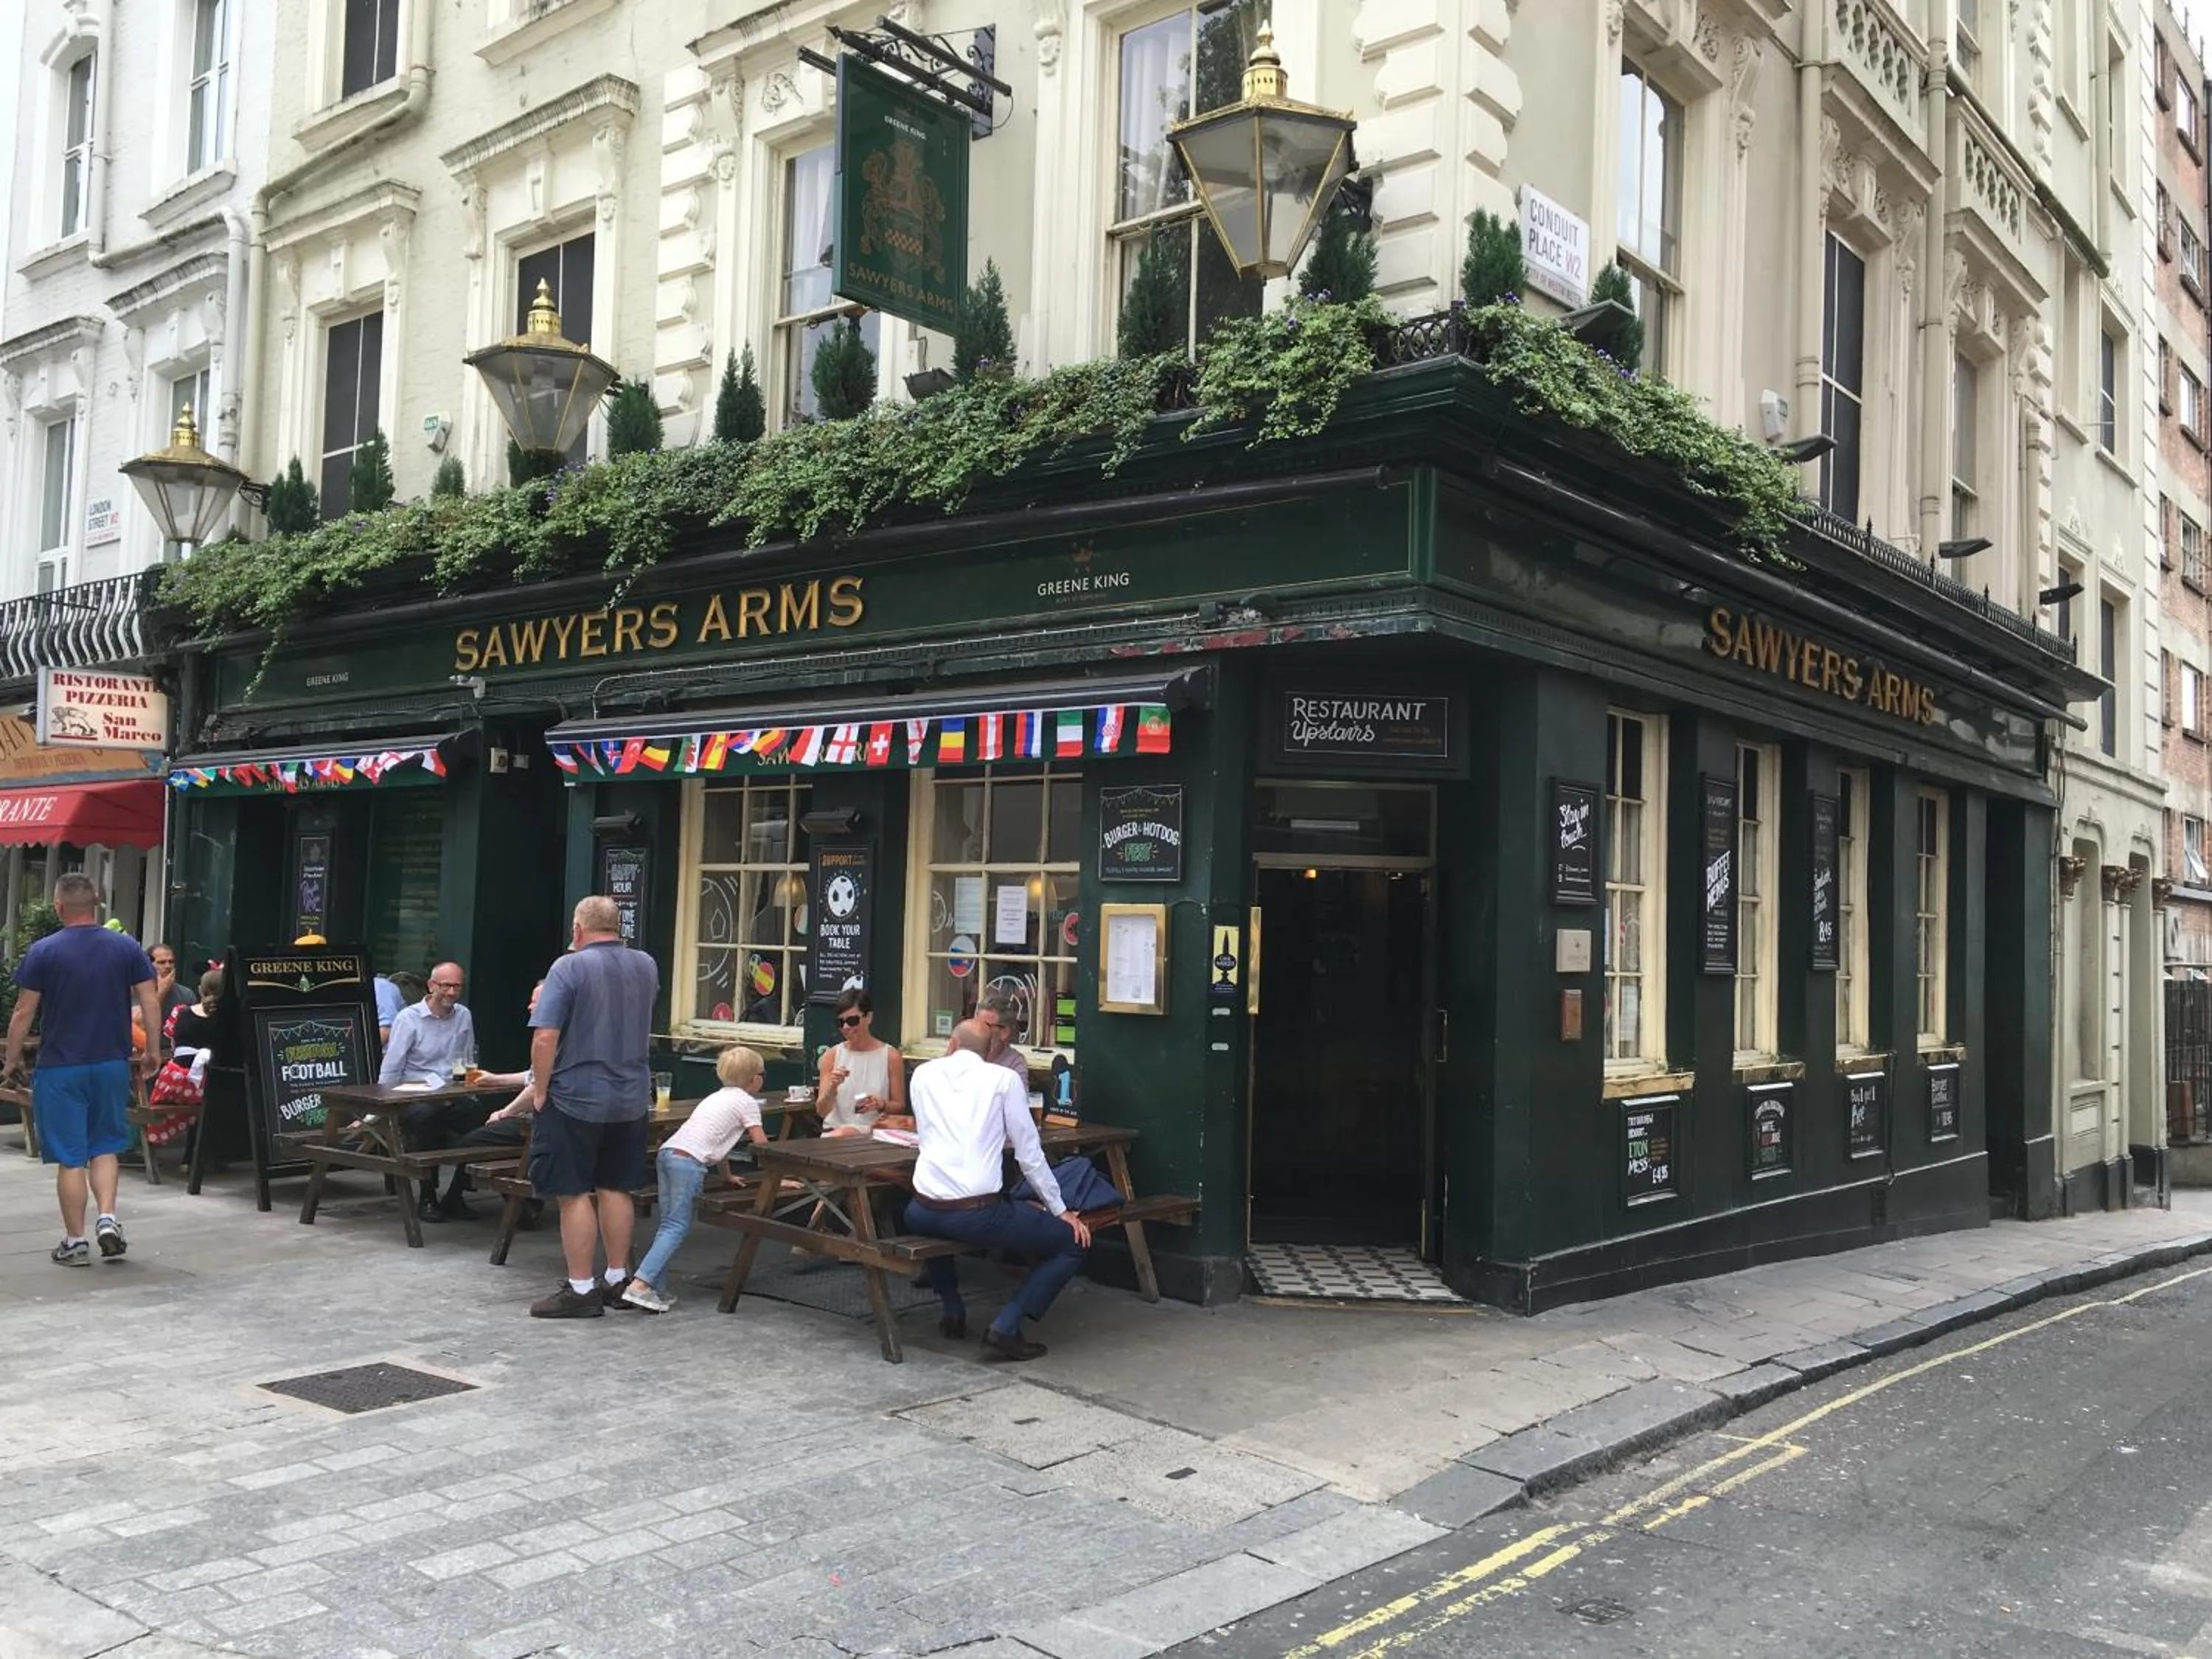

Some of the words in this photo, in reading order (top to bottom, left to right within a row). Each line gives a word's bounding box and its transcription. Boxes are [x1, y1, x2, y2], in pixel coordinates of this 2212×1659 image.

[885, 114, 909, 133] GREENE
[910, 127, 927, 140] KING
[1530, 198, 1579, 247] CONDUIT
[1528, 227, 1562, 268] PLACE
[1565, 249, 1582, 279] W2
[849, 262, 914, 297] SAWYERS
[917, 288, 954, 315] ARMS
[89, 500, 111, 515] LONDON
[88, 514, 108, 530] STREET
[1037, 577, 1090, 597] GREENE
[1093, 572, 1130, 590] KING
[454, 601, 679, 672] SAWYERS
[697, 576, 864, 644] ARMS
[1708, 607, 1860, 700] SAWYERS
[1867, 664, 1935, 726] ARMS
[306, 675, 331, 686] GREENE
[332, 672, 349, 682] KING
[66, 690, 148, 708] PIZZERIA
[102, 712, 137, 726] San
[1292, 698, 1427, 726] RESTAURANT
[103, 726, 162, 742] Marco
[1290, 720, 1375, 747] Upstairs
[1104, 821, 1138, 849] BURGER
[1142, 821, 1179, 846] HOTDOG
[613, 881, 632, 893] HOUR
[820, 924, 840, 937] BOOK
[841, 924, 860, 936] YOUR
[828, 937, 850, 949] TABLE
[250, 961, 313, 974] GREENE
[317, 959, 353, 972] KING
[281, 1060, 348, 1082] FOOTBALL
[280, 1093, 322, 1121] BURGER
